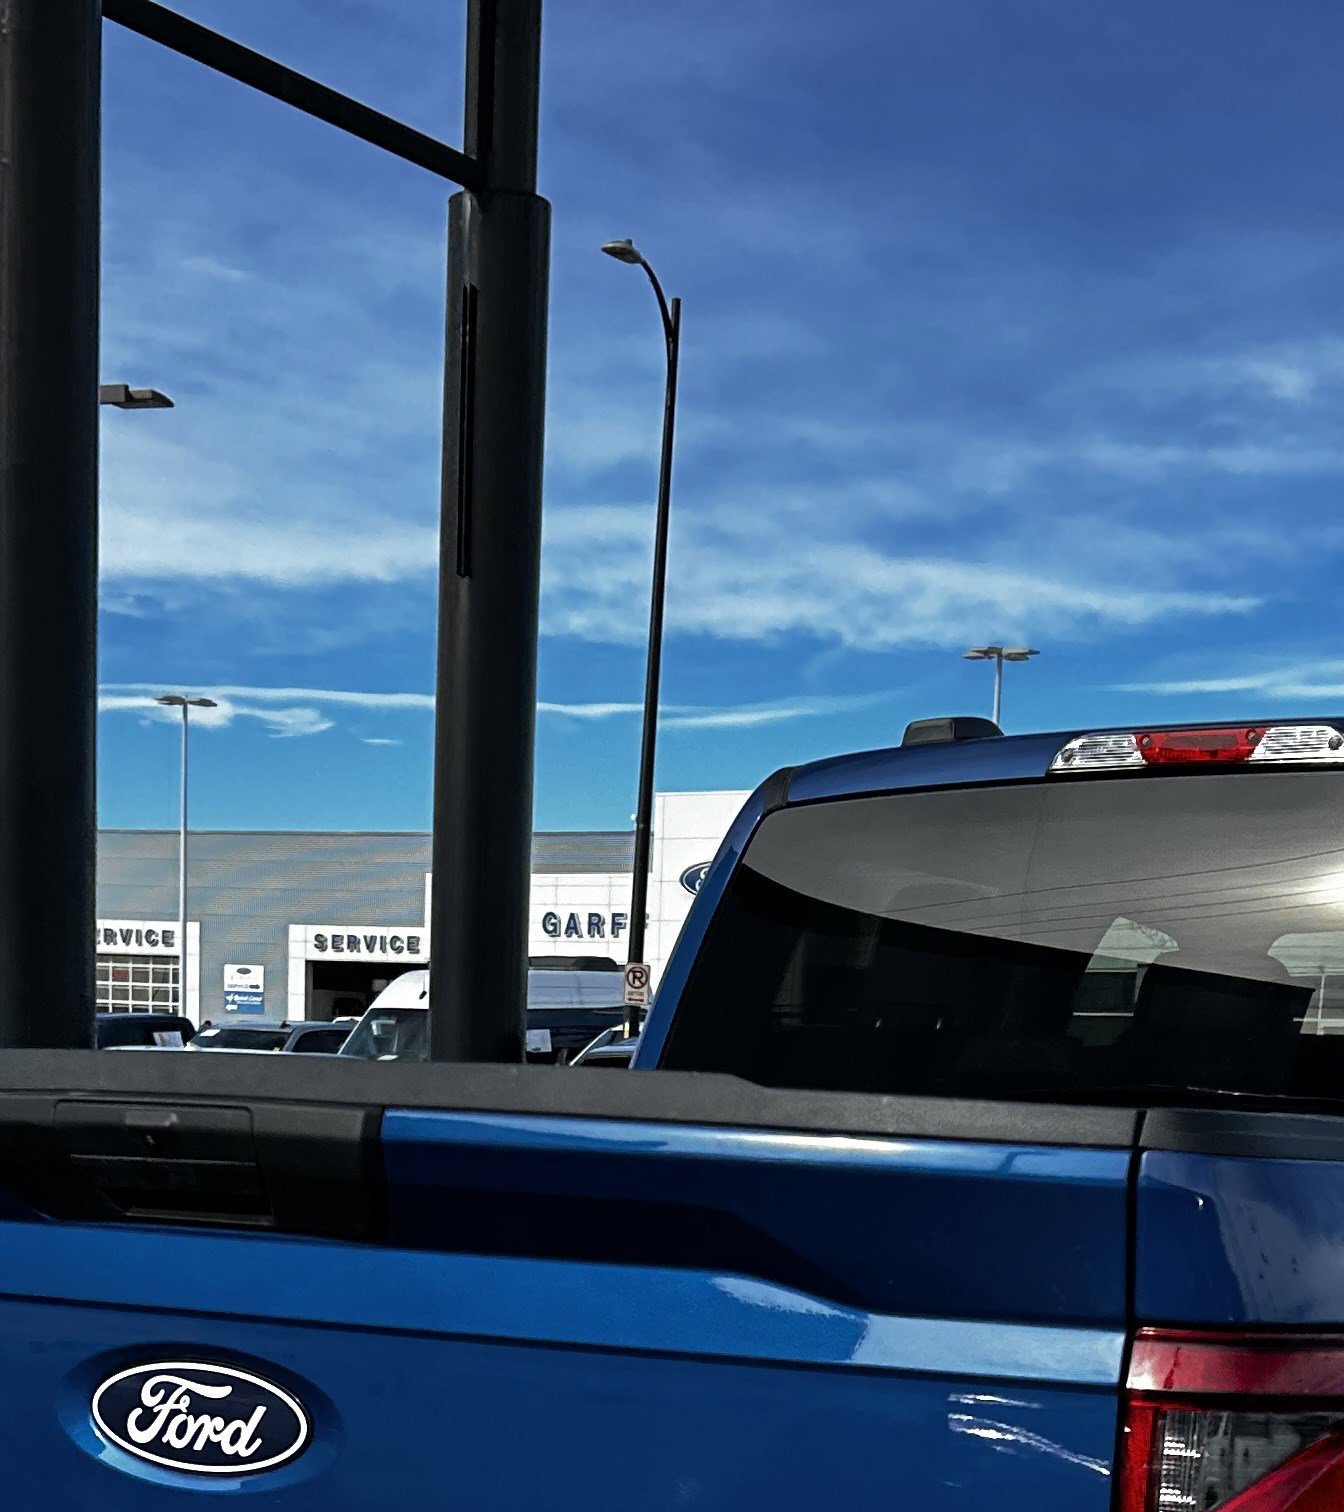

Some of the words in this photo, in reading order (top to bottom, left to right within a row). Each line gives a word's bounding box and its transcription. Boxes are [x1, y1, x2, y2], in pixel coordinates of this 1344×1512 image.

[542, 911, 650, 938] GARF
[96, 928, 175, 948] RVICE
[313, 933, 421, 954] SERVICE
[127, 1374, 267, 1457] Ford
